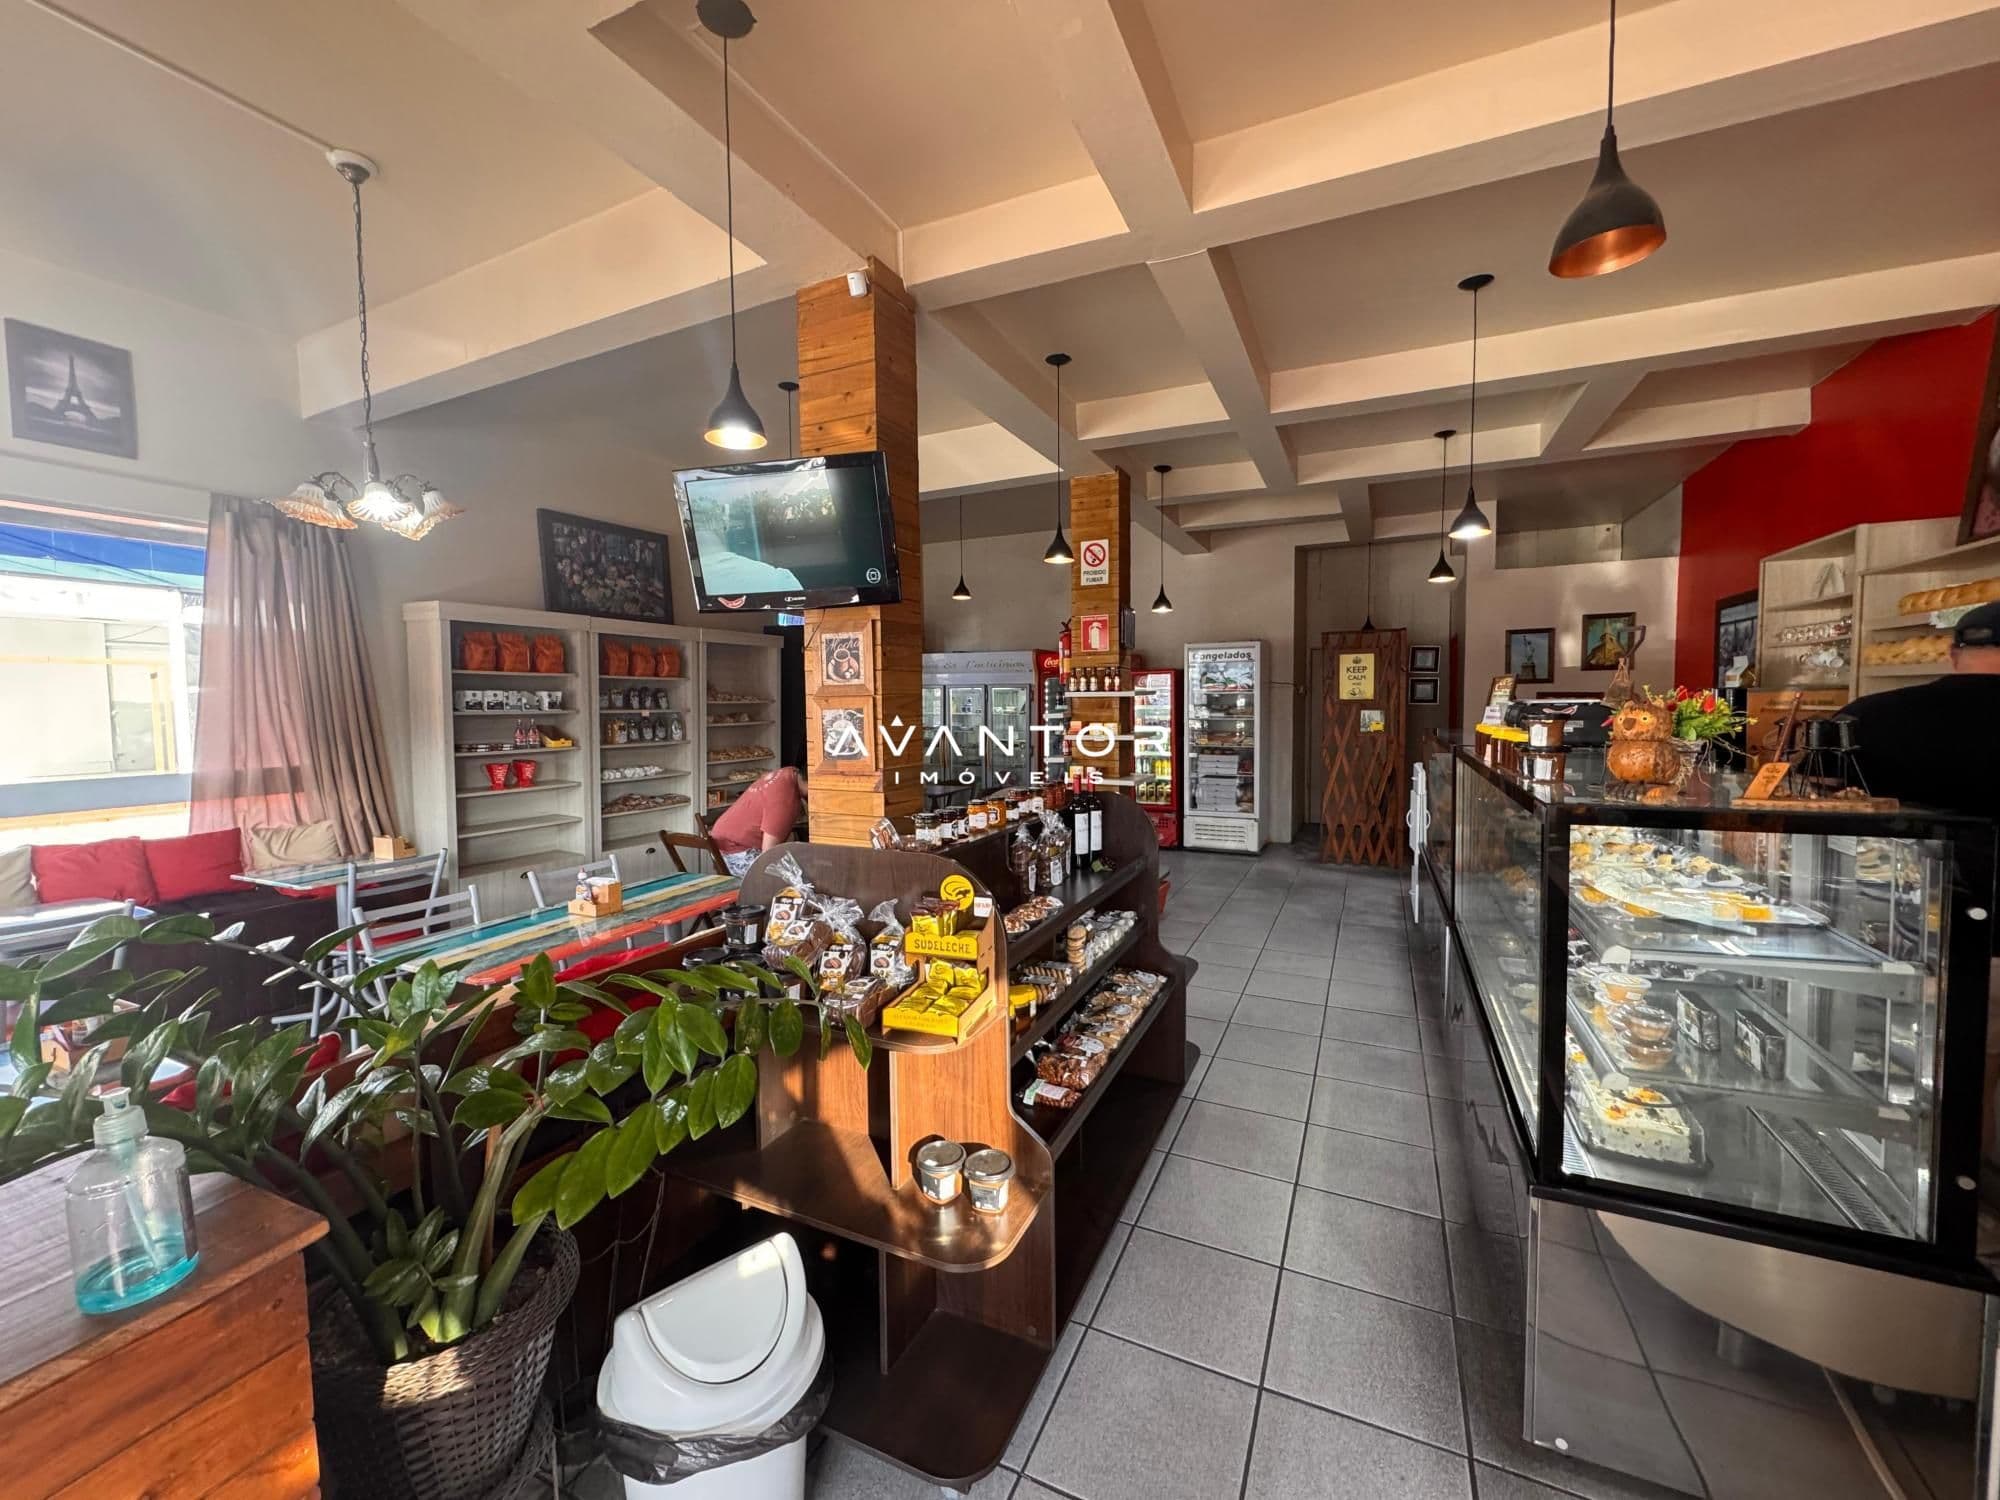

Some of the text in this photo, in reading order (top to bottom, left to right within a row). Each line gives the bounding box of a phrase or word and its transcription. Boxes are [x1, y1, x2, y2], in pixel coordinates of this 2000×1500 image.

[1192, 651, 1252, 662] Congelados
[1346, 665, 1368, 674] KEEP
[914, 939, 972, 954] SUDELECHE
